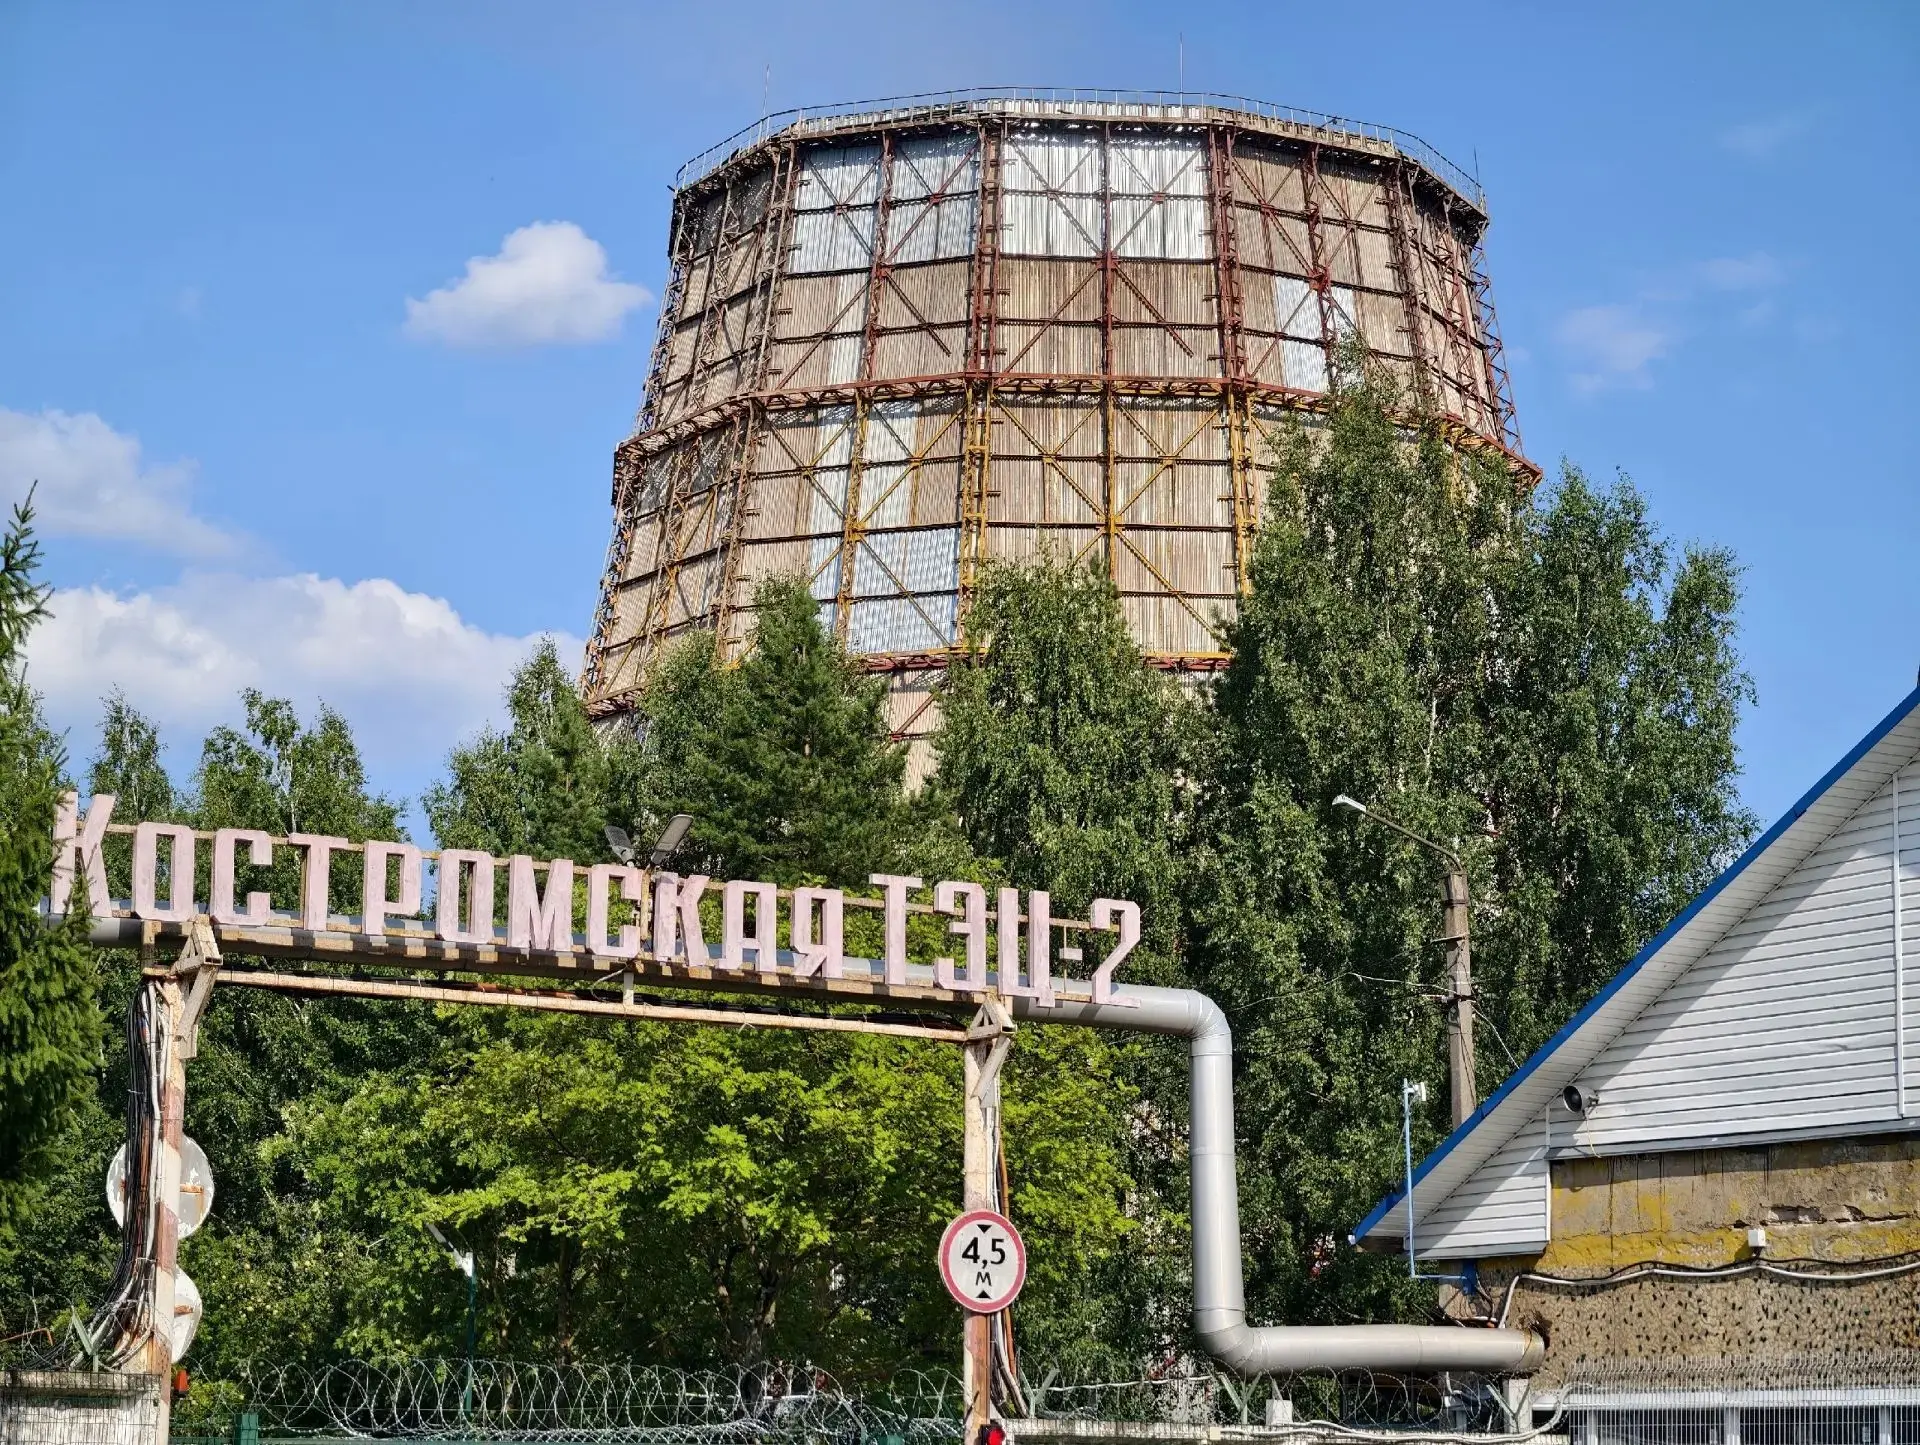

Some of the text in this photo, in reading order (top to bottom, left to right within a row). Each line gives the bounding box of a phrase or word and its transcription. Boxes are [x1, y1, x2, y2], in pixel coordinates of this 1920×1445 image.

[50, 791, 1141, 1007] КОСТРОМСКАЯ ТЭЦ-2
[961, 1237, 1006, 1269] 4,5
